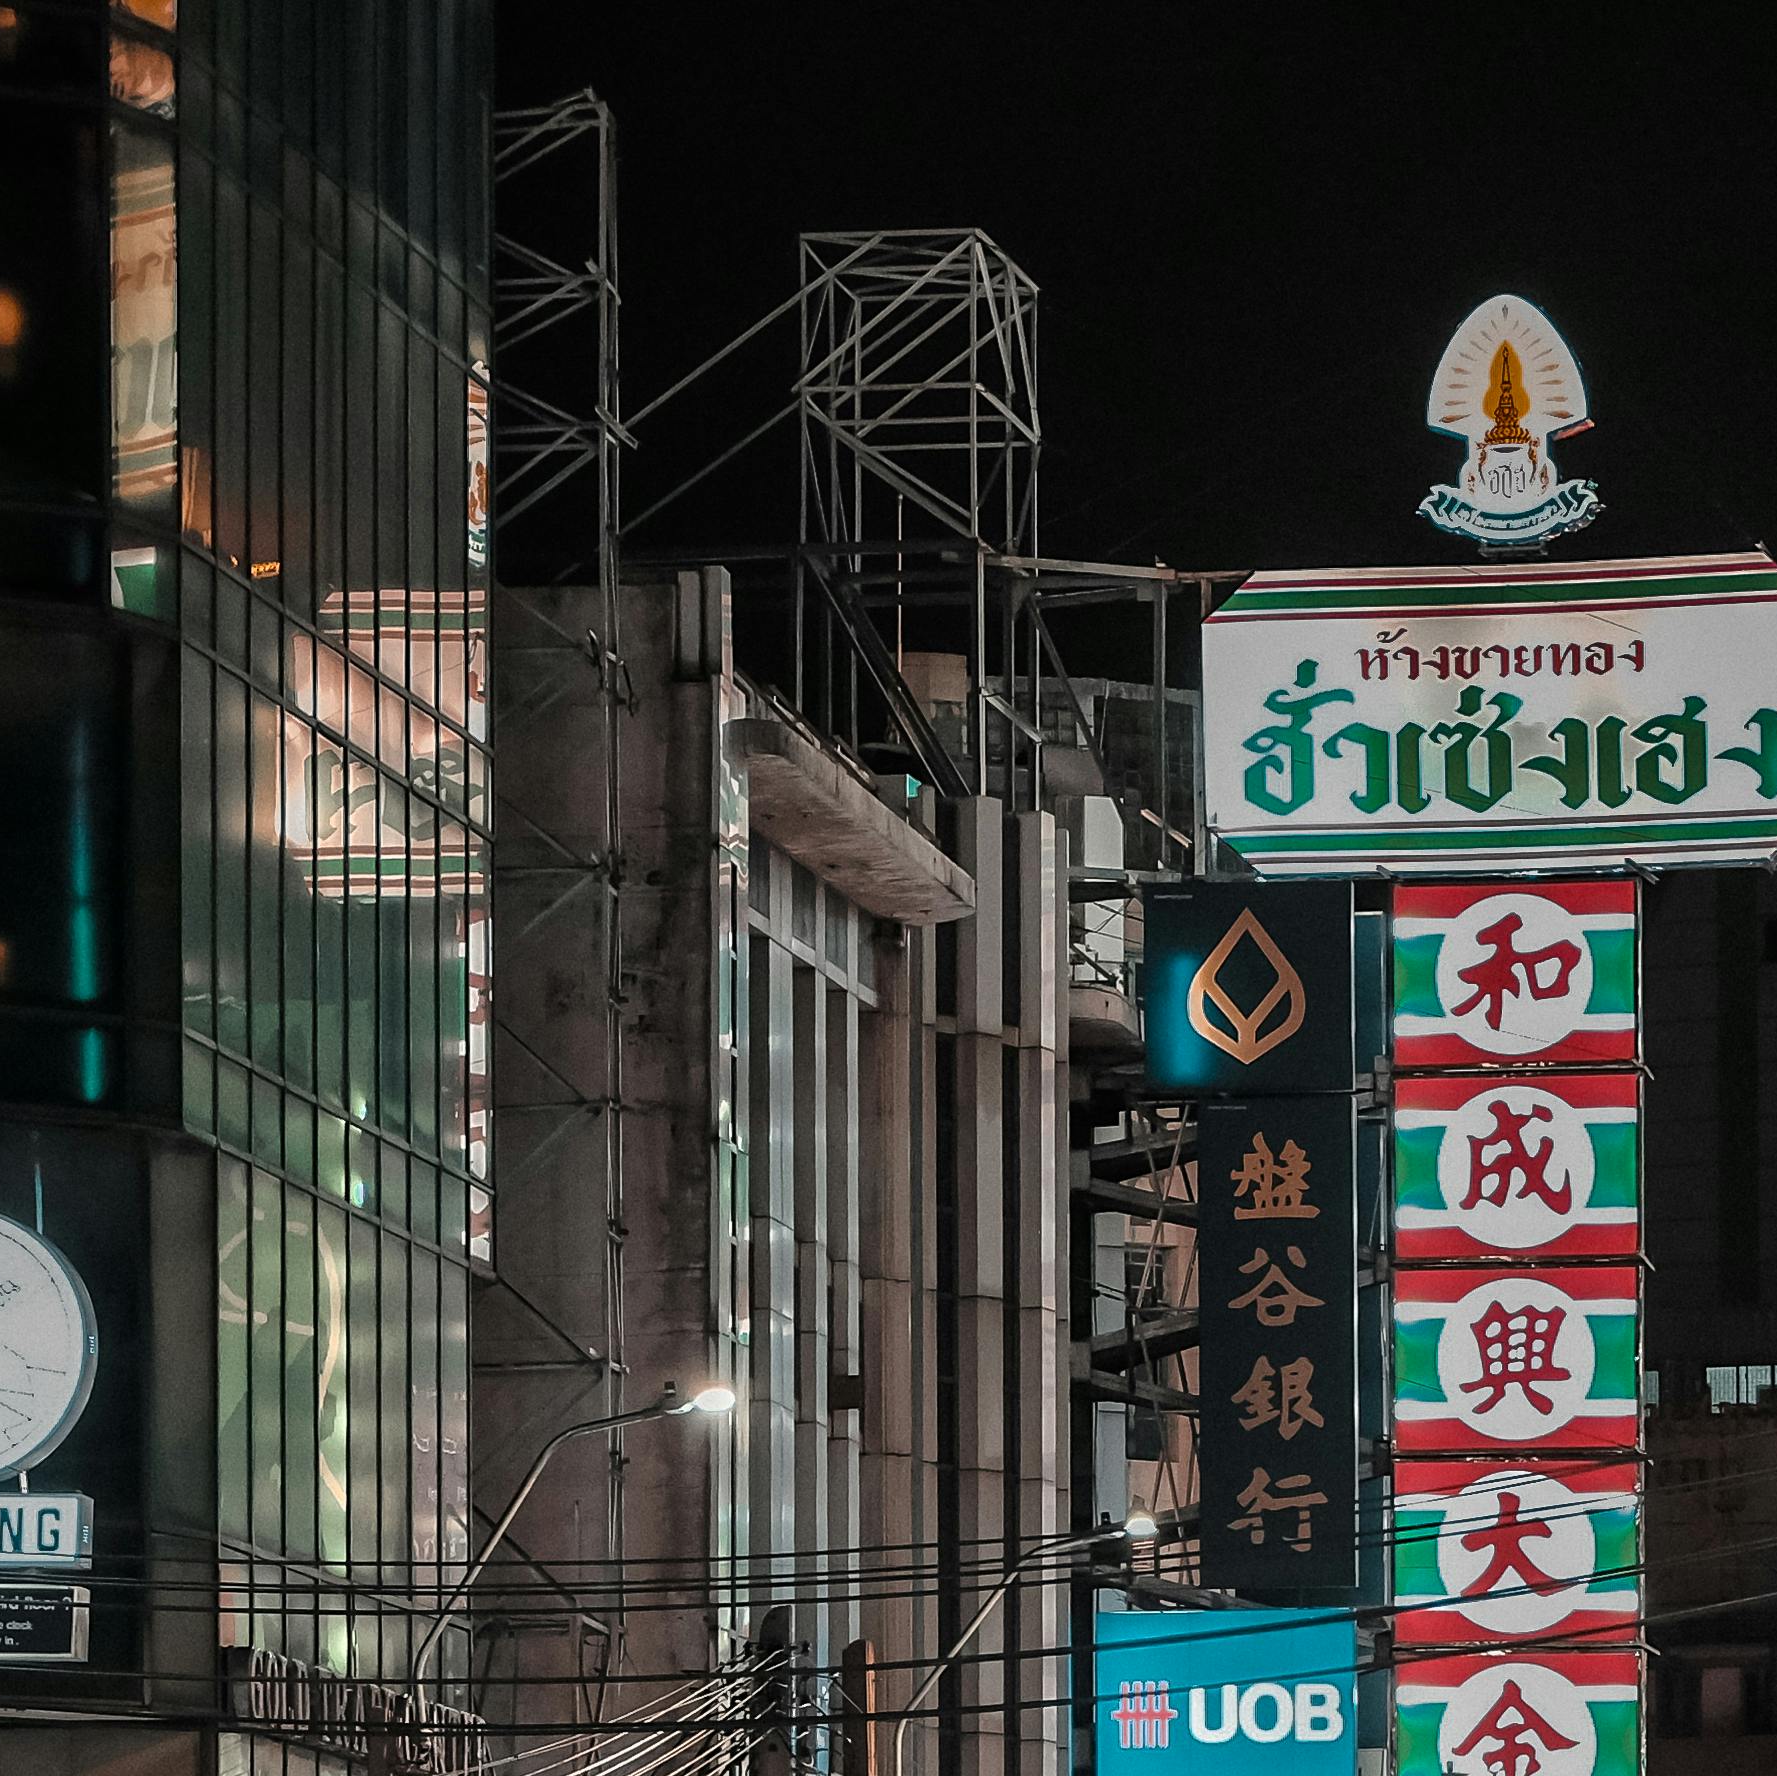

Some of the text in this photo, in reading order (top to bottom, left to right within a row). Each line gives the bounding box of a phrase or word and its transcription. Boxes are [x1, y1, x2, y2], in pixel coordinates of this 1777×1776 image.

[1354, 628, 1645, 682] ห้างขายทอง
[1227, 1131, 1327, 1553] 盤谷銀行
[1188, 1682, 1344, 1744] UOB
